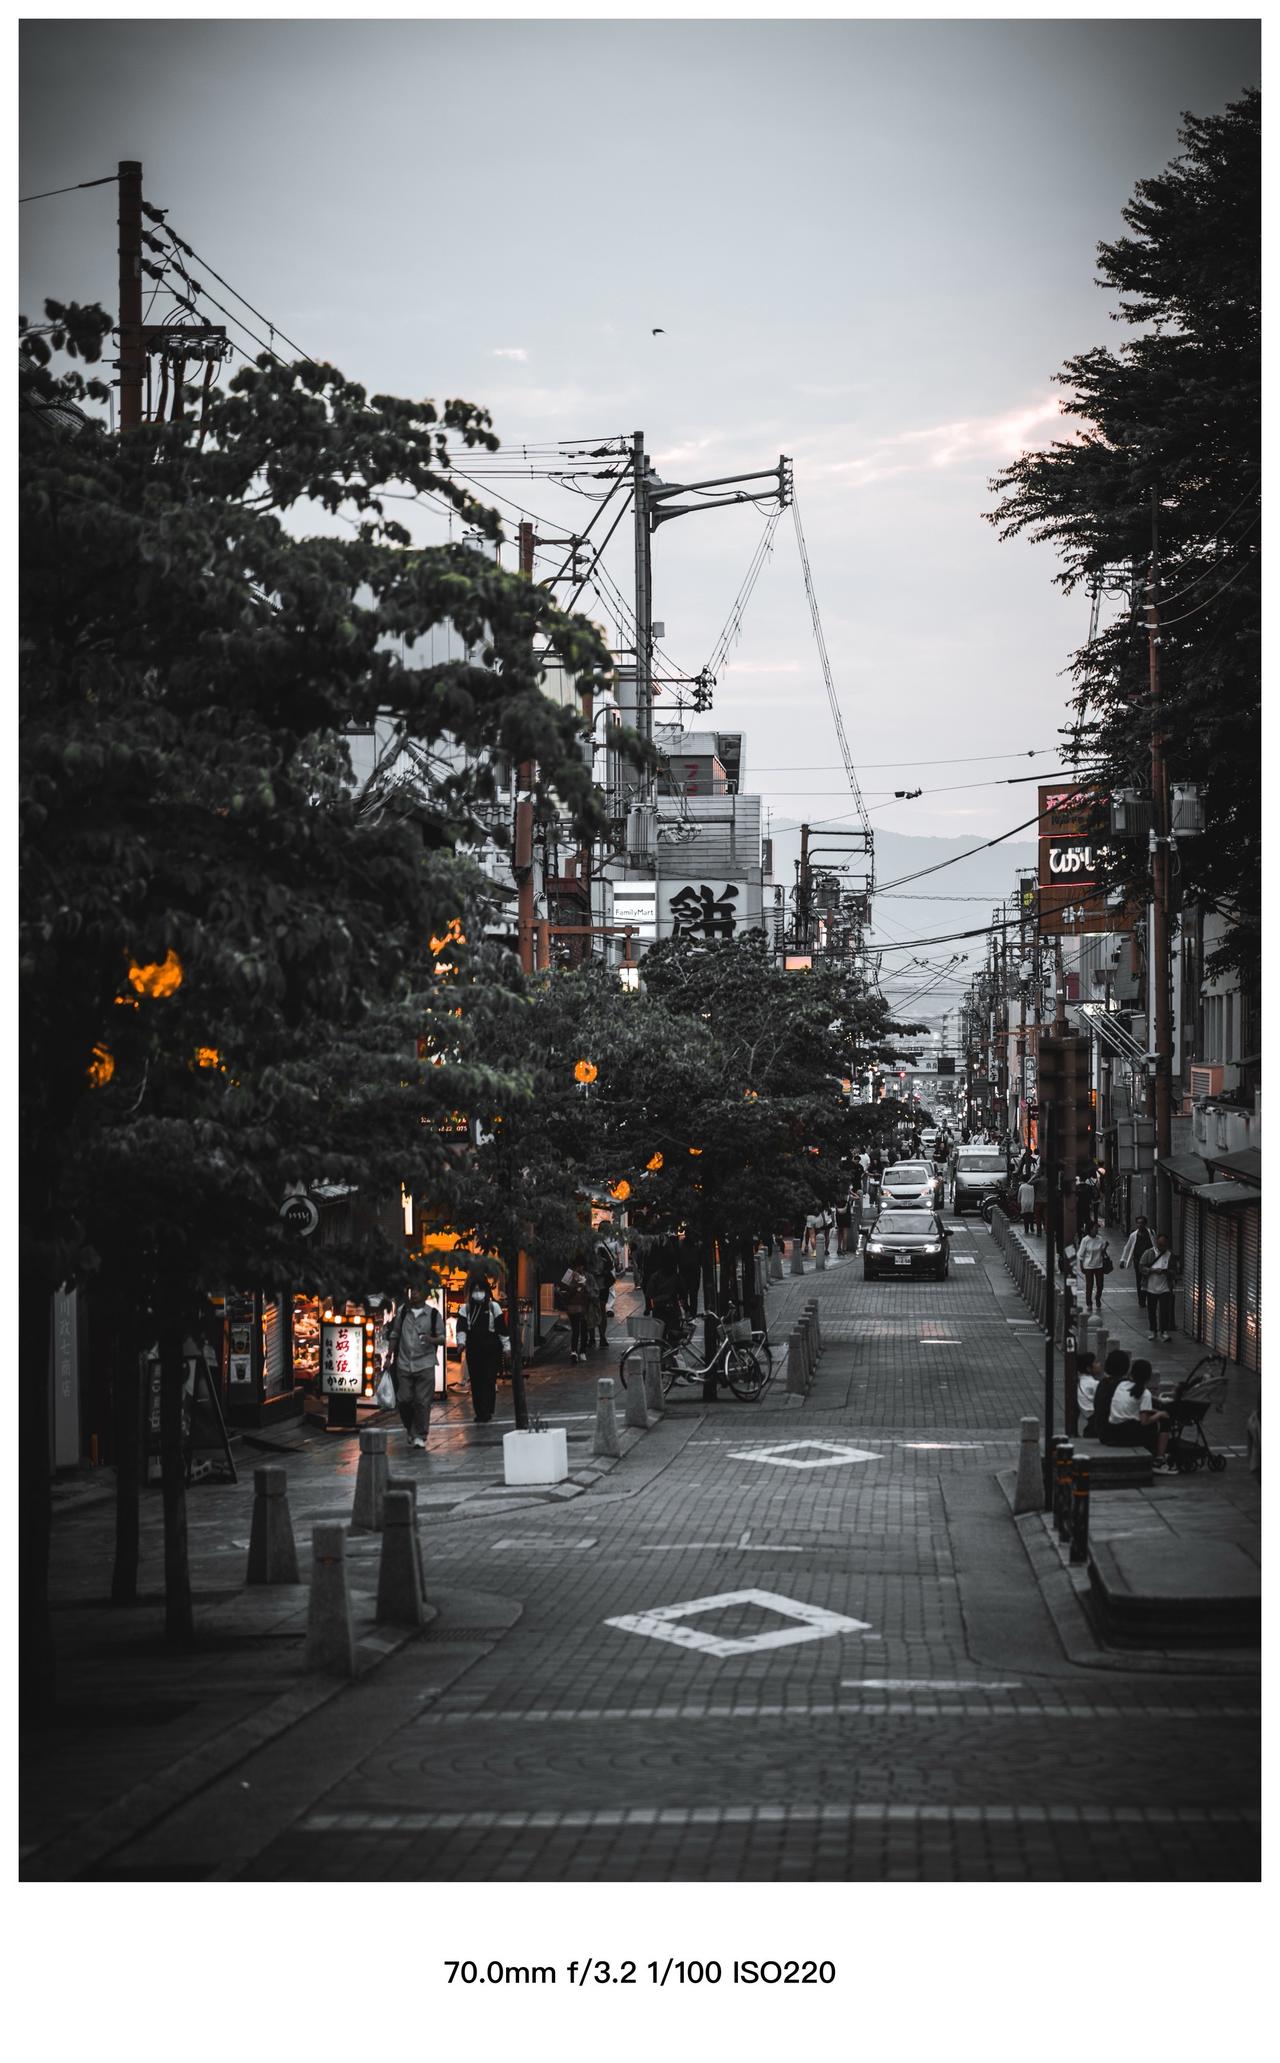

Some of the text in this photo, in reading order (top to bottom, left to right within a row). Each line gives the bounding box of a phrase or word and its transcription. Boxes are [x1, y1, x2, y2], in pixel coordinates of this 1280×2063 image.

[615, 909, 654, 917] FamilyMart
[327, 1375, 358, 1386] かめや
